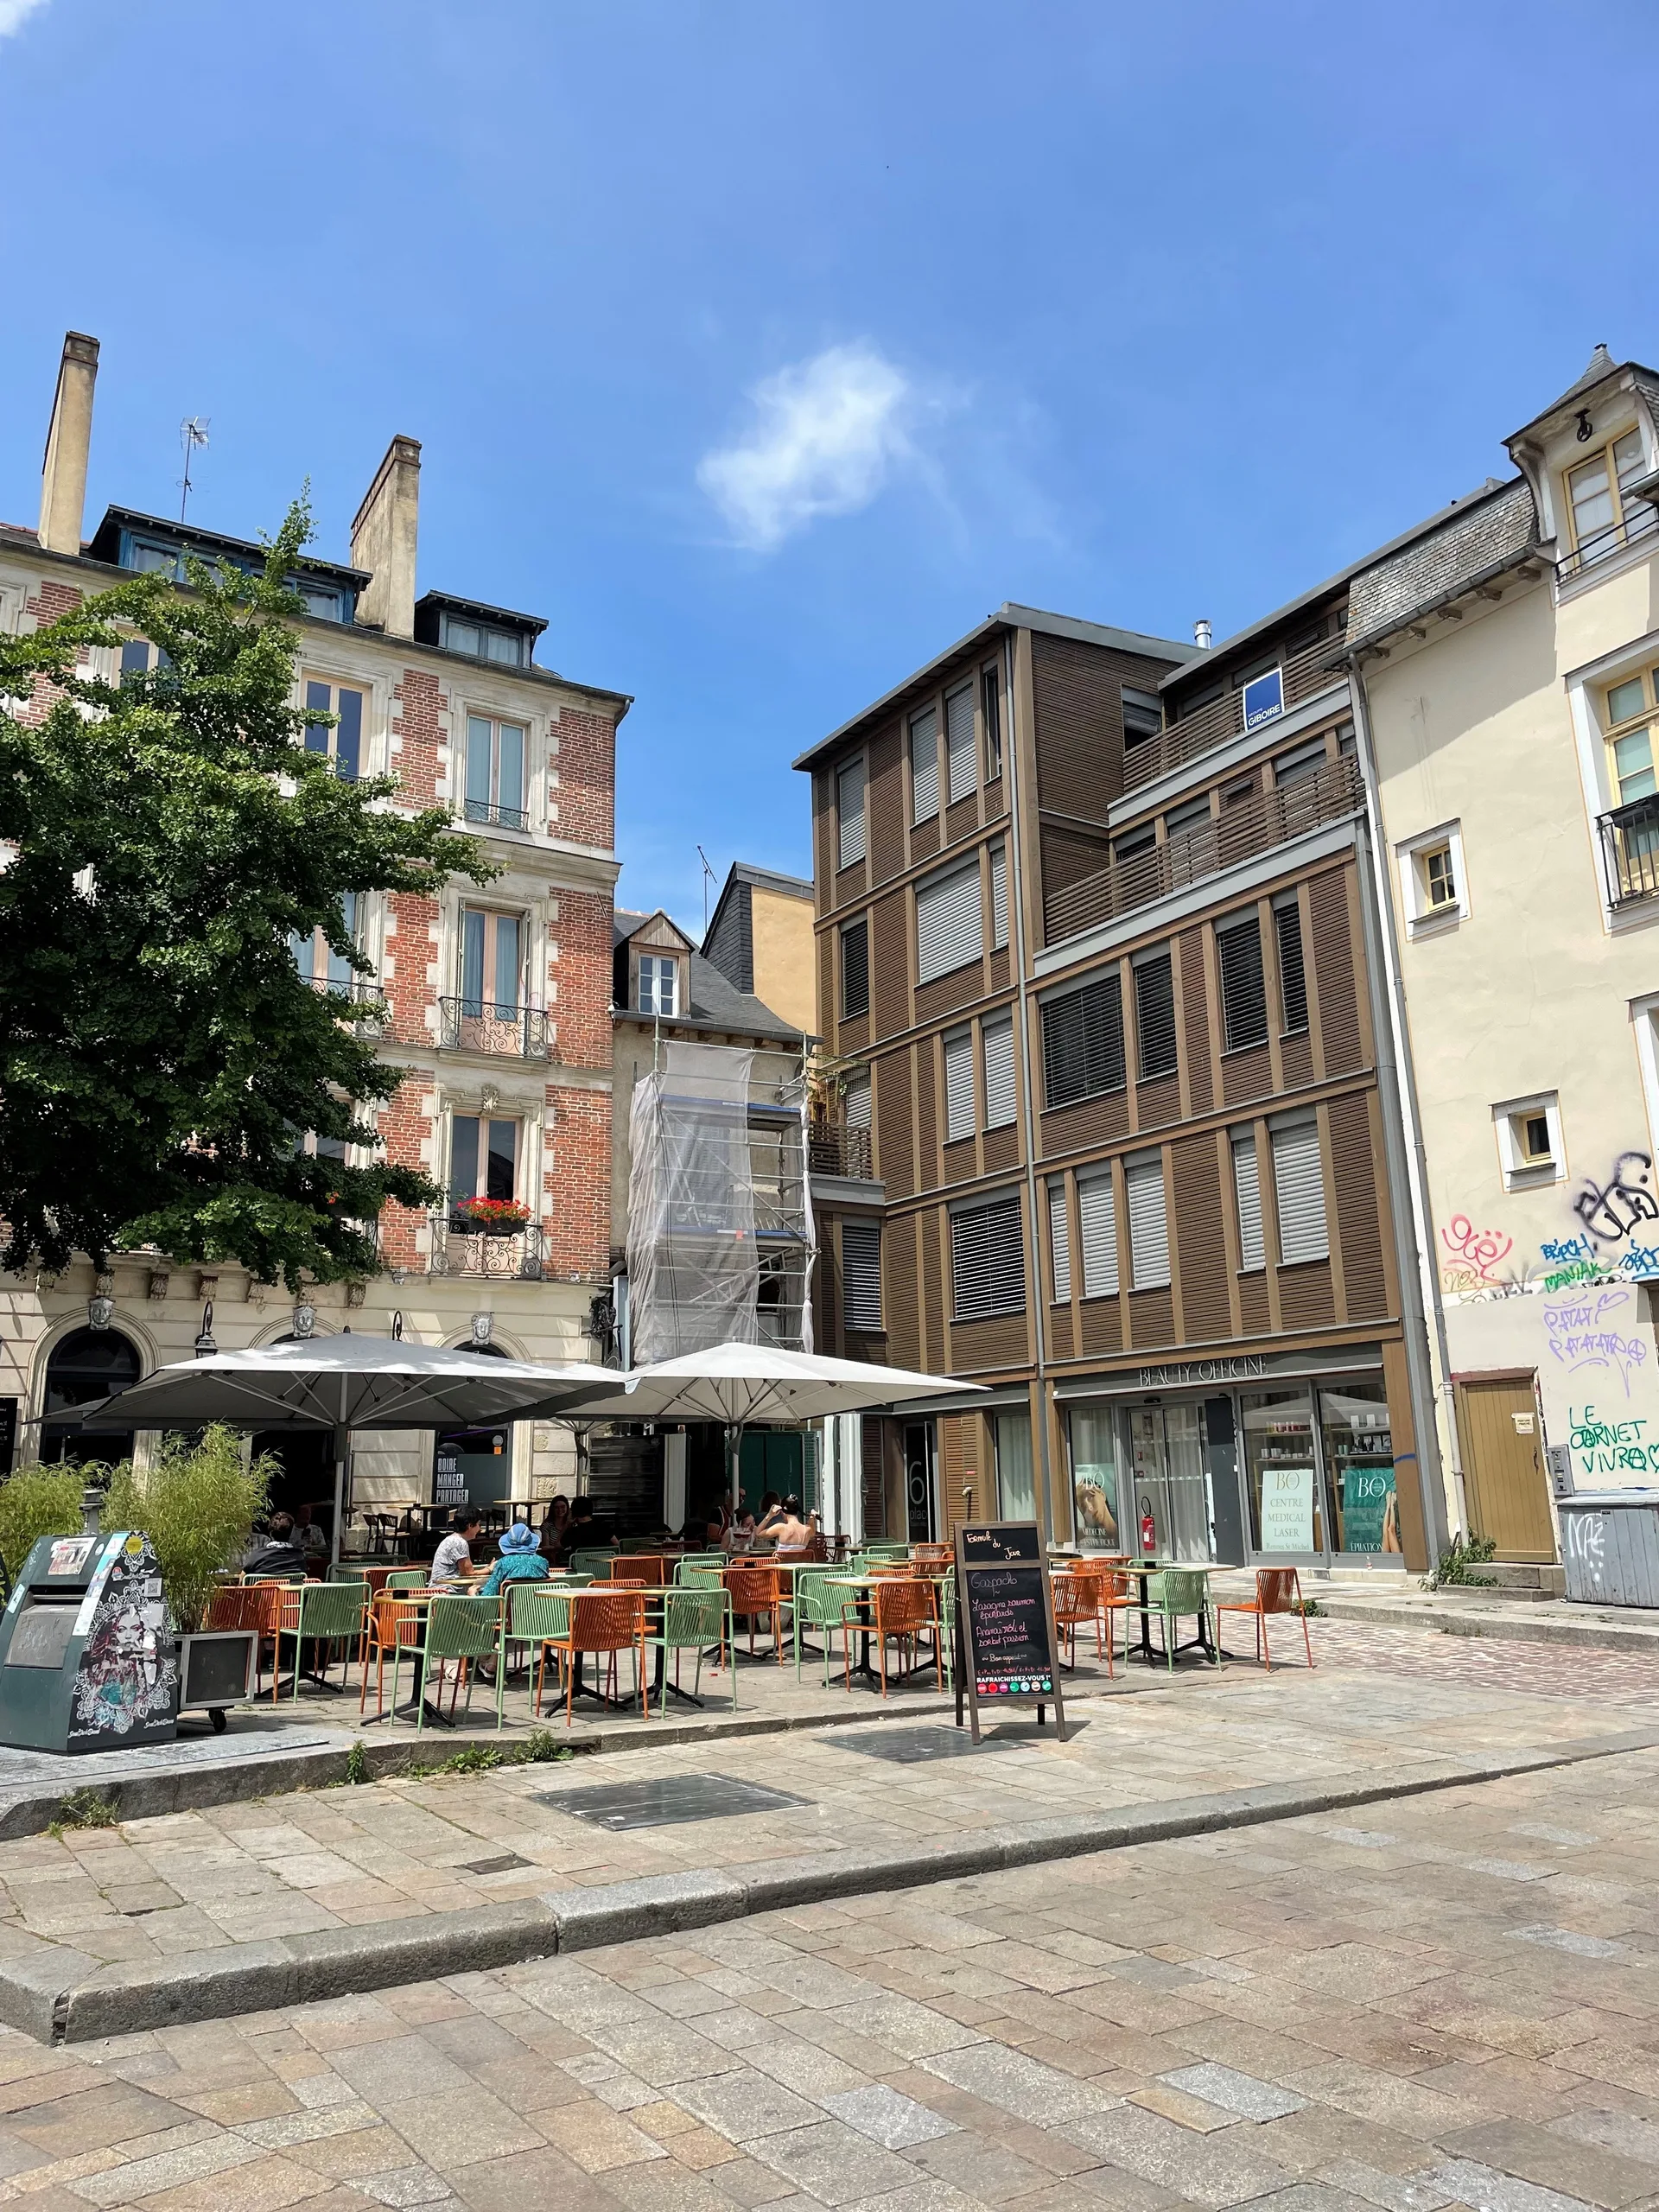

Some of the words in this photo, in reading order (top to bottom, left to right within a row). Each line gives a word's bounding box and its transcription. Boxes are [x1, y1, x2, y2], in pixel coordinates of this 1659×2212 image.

[1249, 704, 1281, 726] GIBOIRE
[1545, 1262, 1612, 1294] MANIAK
[1139, 1363, 1192, 1387] BEAUTY
[1198, 1354, 1269, 1381] OFFICINE
[1569, 1406, 1602, 1429] LE
[437, 1458, 456, 1471] BOIRE
[436, 1473, 464, 1486] MANGER
[909, 1460, 925, 1504] 6
[1085, 1472, 1105, 1491] BO
[1276, 1471, 1300, 1491] BO
[1357, 1476, 1386, 1497] BO
[435, 1489, 469, 1503] PARTAGER
[1270, 1498, 1304, 1508] CENTRE
[1268, 1513, 1306, 1522] MEDICAL
[1274, 1528, 1300, 1537] LASER
[992, 1538, 1001, 1548] du
[970, 1572, 1018, 1596] Gaspacho
[972, 1599, 1006, 1612] Lasagne
[988, 1653, 1002, 1662] Bon
